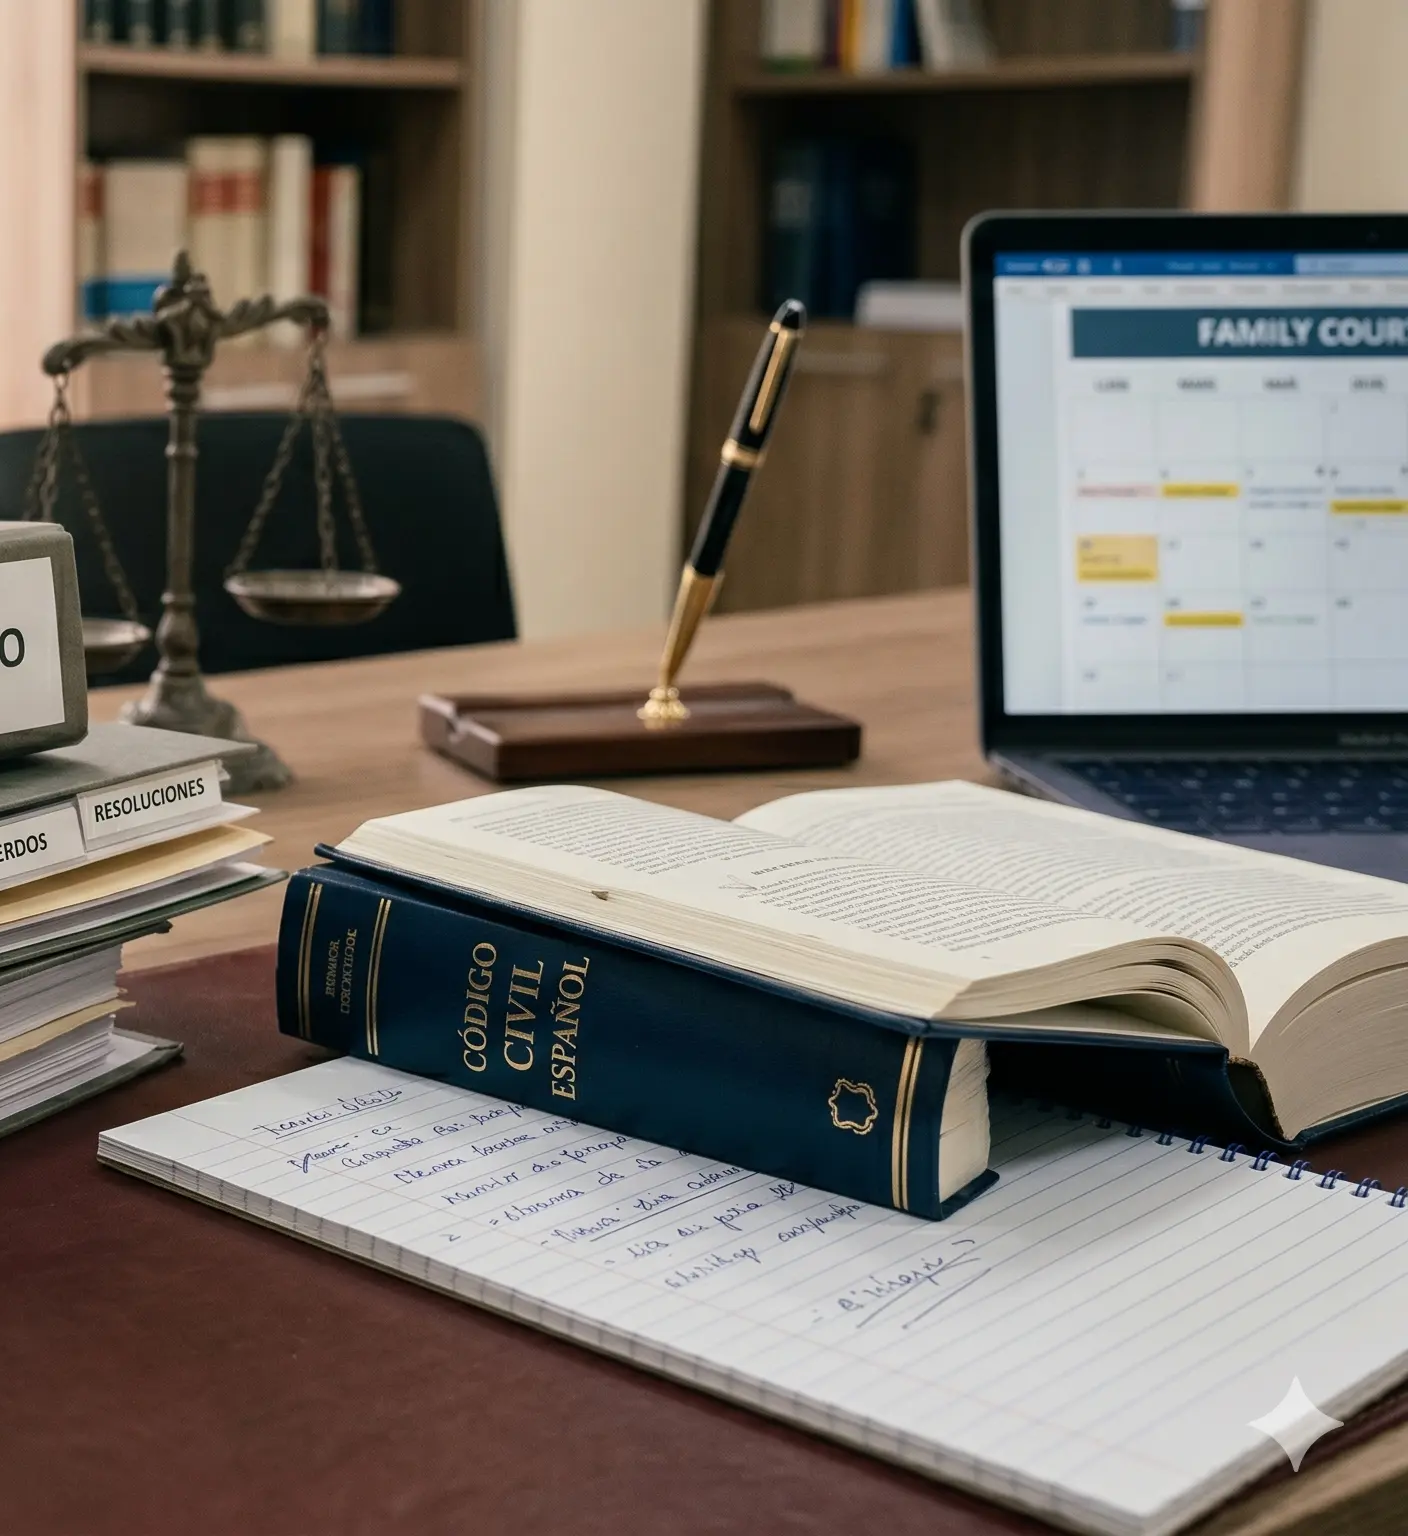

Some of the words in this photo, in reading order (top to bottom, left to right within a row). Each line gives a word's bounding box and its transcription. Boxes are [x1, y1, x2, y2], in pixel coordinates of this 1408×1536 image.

[1197, 317, 1314, 347] FAMILY
[1317, 317, 1408, 347] COUR
[94, 777, 205, 823] RESOLUCIONES
[457, 942, 497, 1072] CÓDIGO
[503, 960, 544, 1071] CIVIL
[550, 956, 590, 1100] ESPAÑOL
